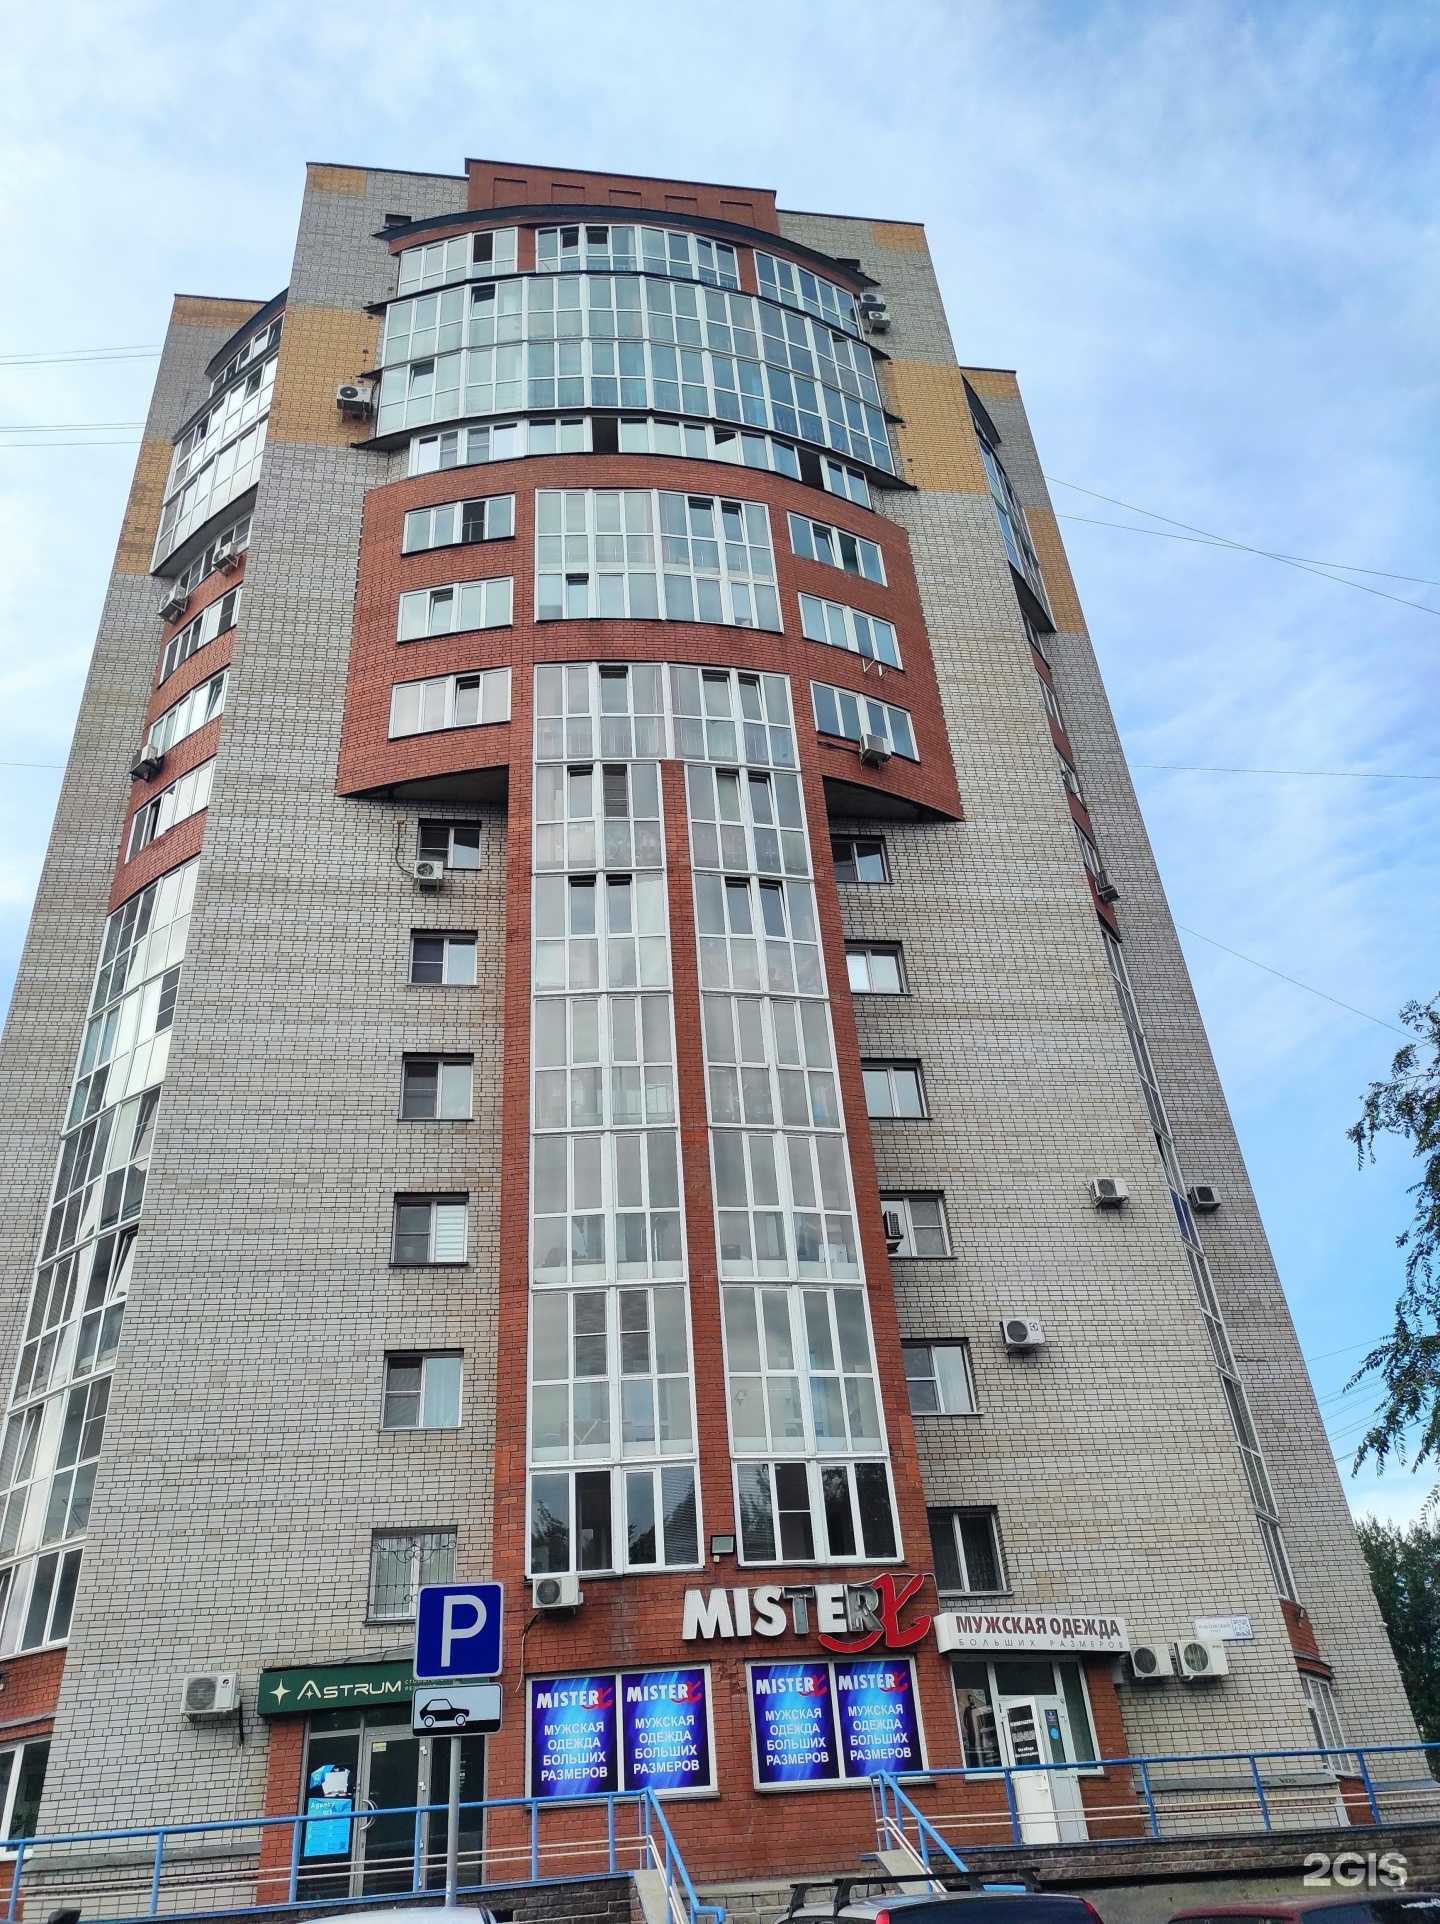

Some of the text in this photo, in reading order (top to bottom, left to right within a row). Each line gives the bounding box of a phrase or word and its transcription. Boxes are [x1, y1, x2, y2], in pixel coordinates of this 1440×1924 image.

[683, 1584, 884, 1640] MISTER
[440, 1594, 487, 1668] P
[955, 1615, 1121, 1639] МУЖСКАЯ ОДЕЖДА
[958, 1638, 1037, 1648] БОЛЬШИХ
[755, 1677, 815, 1695] MISTER
[838, 1673, 896, 1691] MISTER
[536, 1689, 599, 1709] MISTER
[626, 1683, 689, 1703] MISTER
[765, 1707, 822, 1721] МУЖСКАЯ
[847, 1703, 904, 1717] МУЖСКАЯ
[544, 1721, 605, 1736] МУЖСКАЯ
[635, 1715, 695, 1729] МУЖСКАЯ
[852, 1718, 903, 1732] ОДЕЖДА
[639, 1730, 692, 1745] ОДЕЖДА
[769, 1723, 821, 1737] ОДЕЖДА
[547, 1737, 601, 1752] ОДЕЖДА
[766, 1736, 827, 1751] БОЛЬШИХ
[850, 1732, 909, 1746] БОЛЬШИХ
[543, 1751, 606, 1766] БОЛЬШИХ
[634, 1744, 698, 1760] БОЛЬШИХ
[766, 1751, 830, 1766] РАЗМЕРОВ
[849, 1746, 912, 1761] РАЗМЕРОВ
[541, 1766, 608, 1782] РАЗМЕРОВ
[633, 1759, 700, 1774] РАЗМЕРОВ
